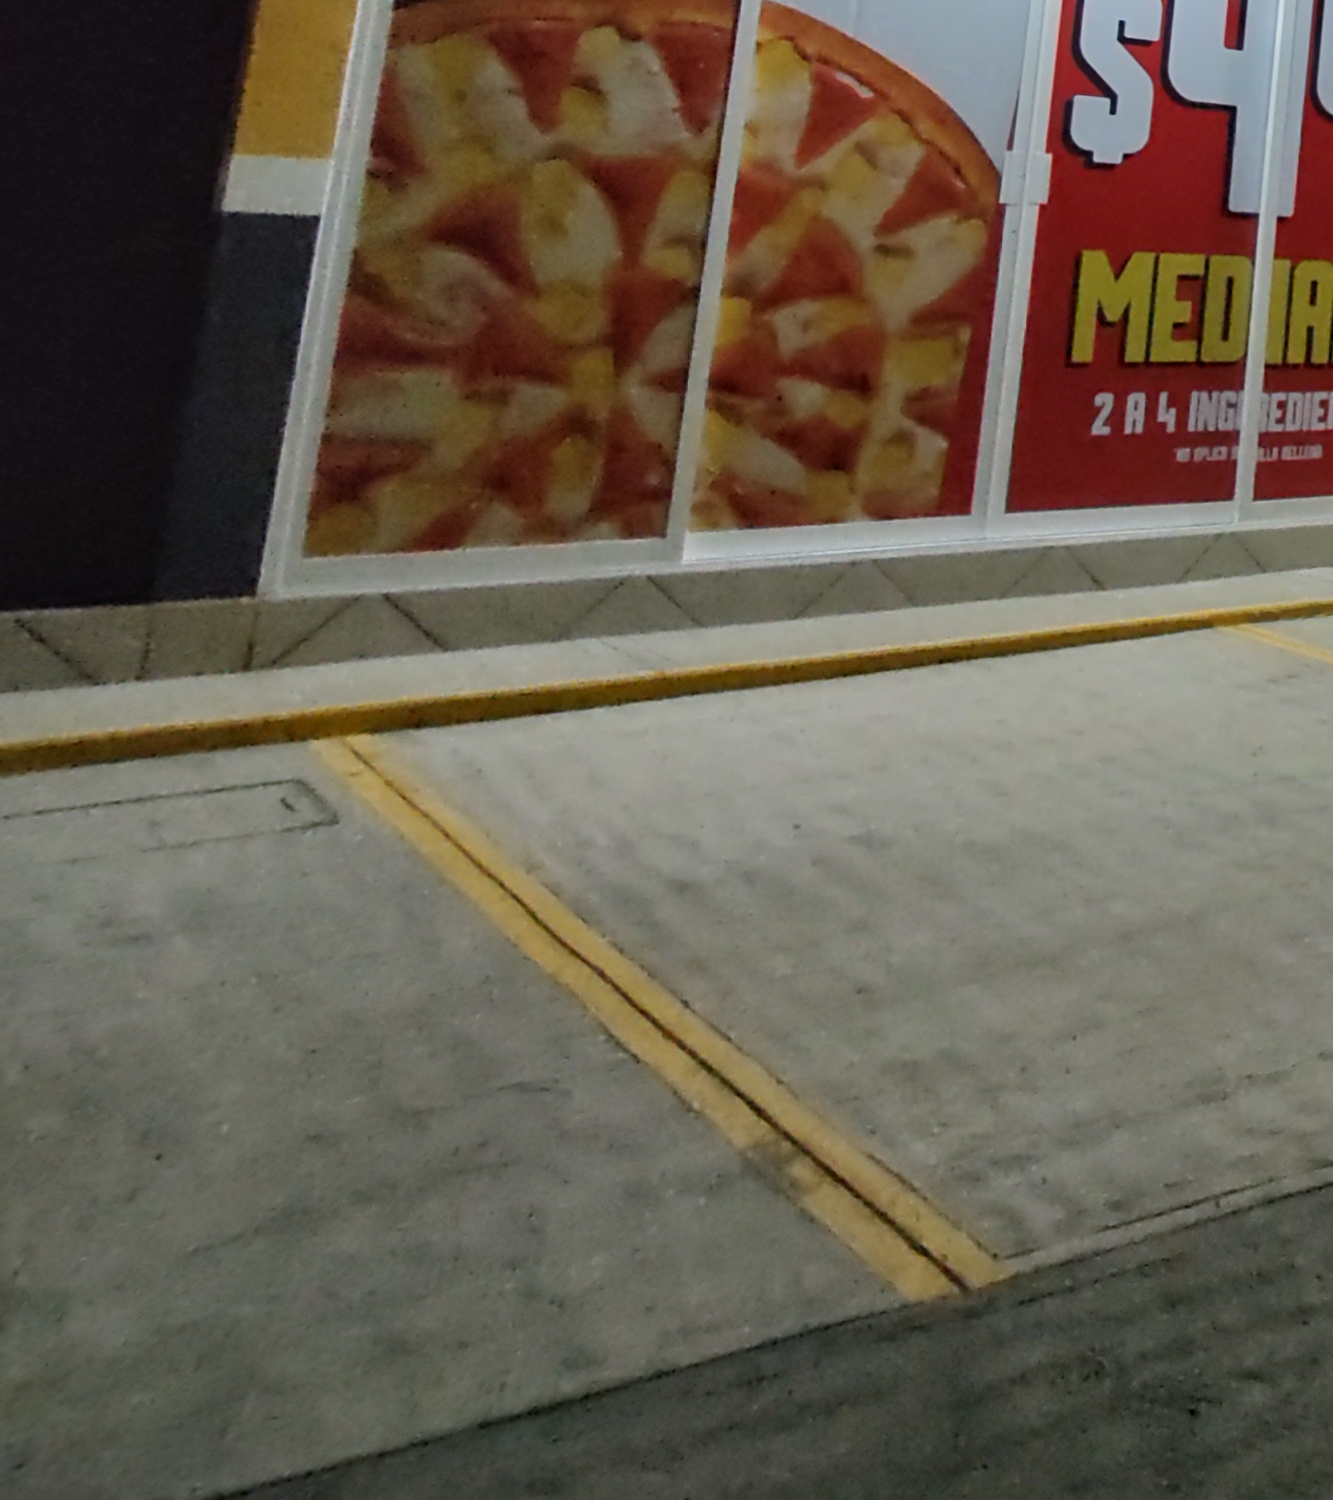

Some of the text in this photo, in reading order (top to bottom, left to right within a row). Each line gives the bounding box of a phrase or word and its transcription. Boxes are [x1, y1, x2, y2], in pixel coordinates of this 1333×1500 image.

[1091, 392, 1115, 436] 2
[1124, 392, 1146, 435] A
[1156, 391, 1176, 433] 4
